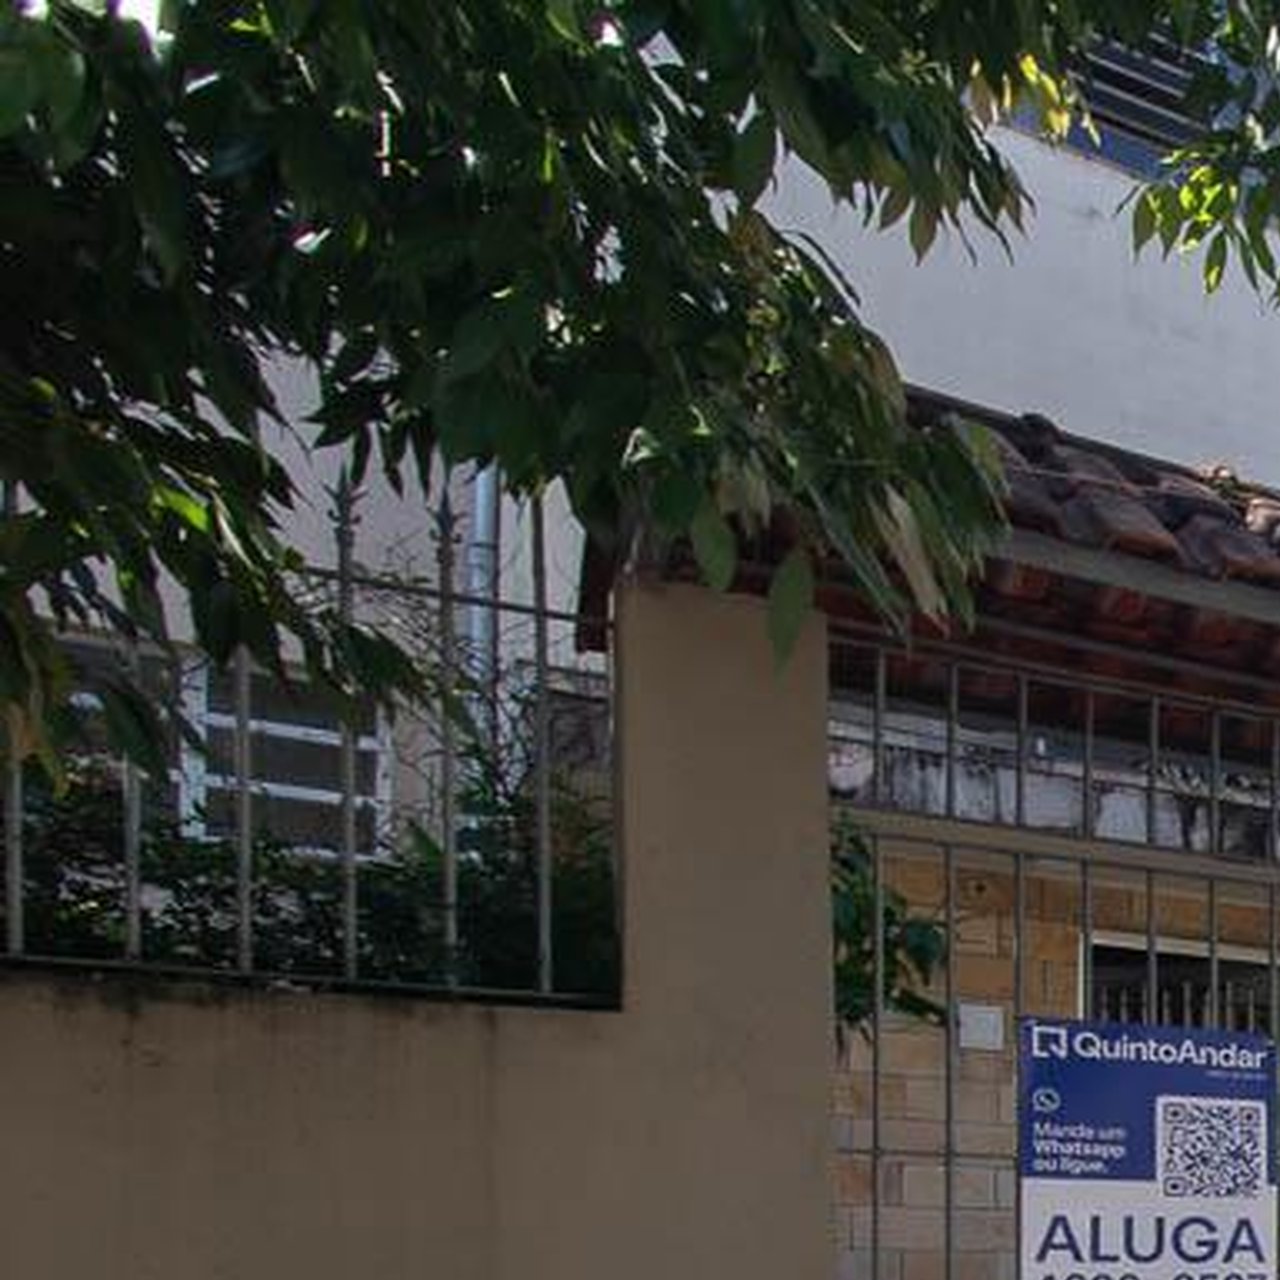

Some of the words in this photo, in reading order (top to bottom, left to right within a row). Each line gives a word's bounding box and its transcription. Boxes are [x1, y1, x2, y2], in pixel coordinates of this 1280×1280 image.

[1073, 1031, 1267, 1069] QuintoAndar
[1033, 1158, 1058, 1172] ou
[1034, 1215, 1266, 1264] ALUGA
